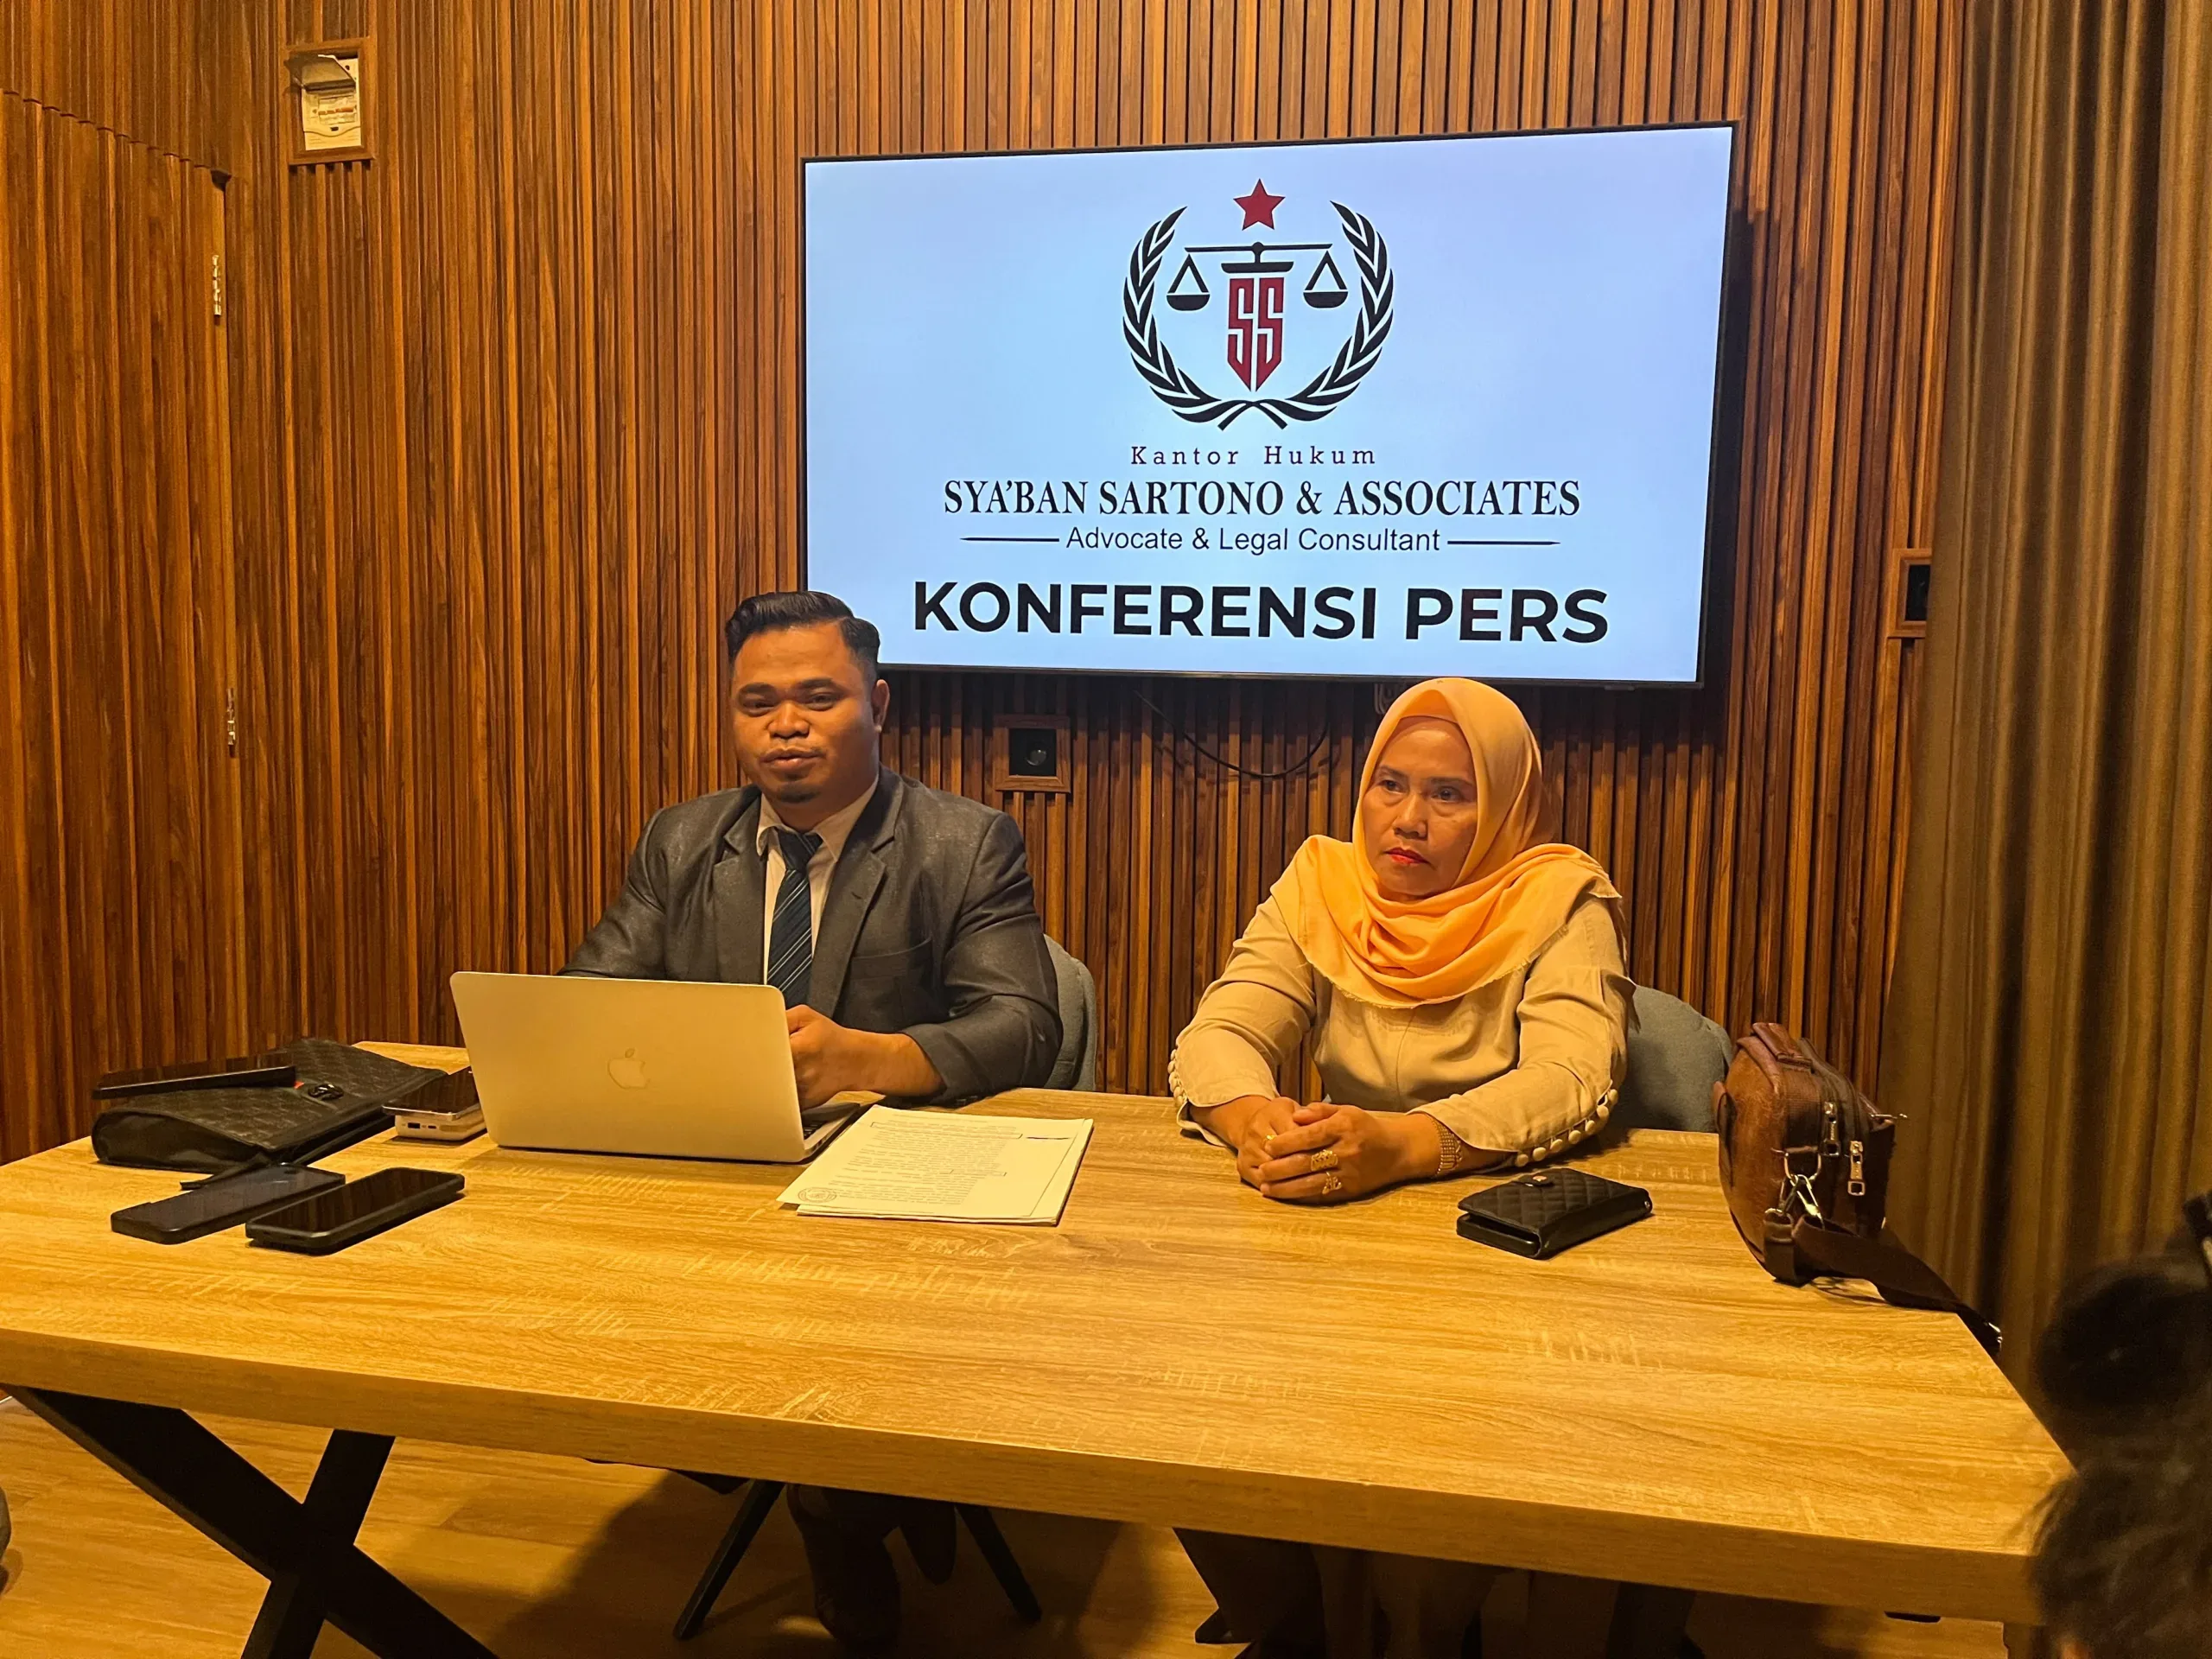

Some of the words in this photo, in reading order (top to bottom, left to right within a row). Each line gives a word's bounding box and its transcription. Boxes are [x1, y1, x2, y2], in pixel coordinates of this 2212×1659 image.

[1227, 277, 1285, 392] SS
[1130, 446, 1239, 466] Kantor
[1263, 445, 1376, 465] Hukum
[944, 480, 1089, 514] SYA'BAN
[1099, 480, 1284, 516] SARTONO
[1296, 480, 1323, 515] &
[1333, 480, 1580, 516] ASSOCIATES
[1065, 526, 1183, 550] Advocate
[1192, 527, 1210, 550] &
[1219, 527, 1288, 556] Legal
[1298, 527, 1440, 551] Consultant
[914, 581, 1376, 639] KONFERENSI
[1405, 588, 1608, 644] PERS
